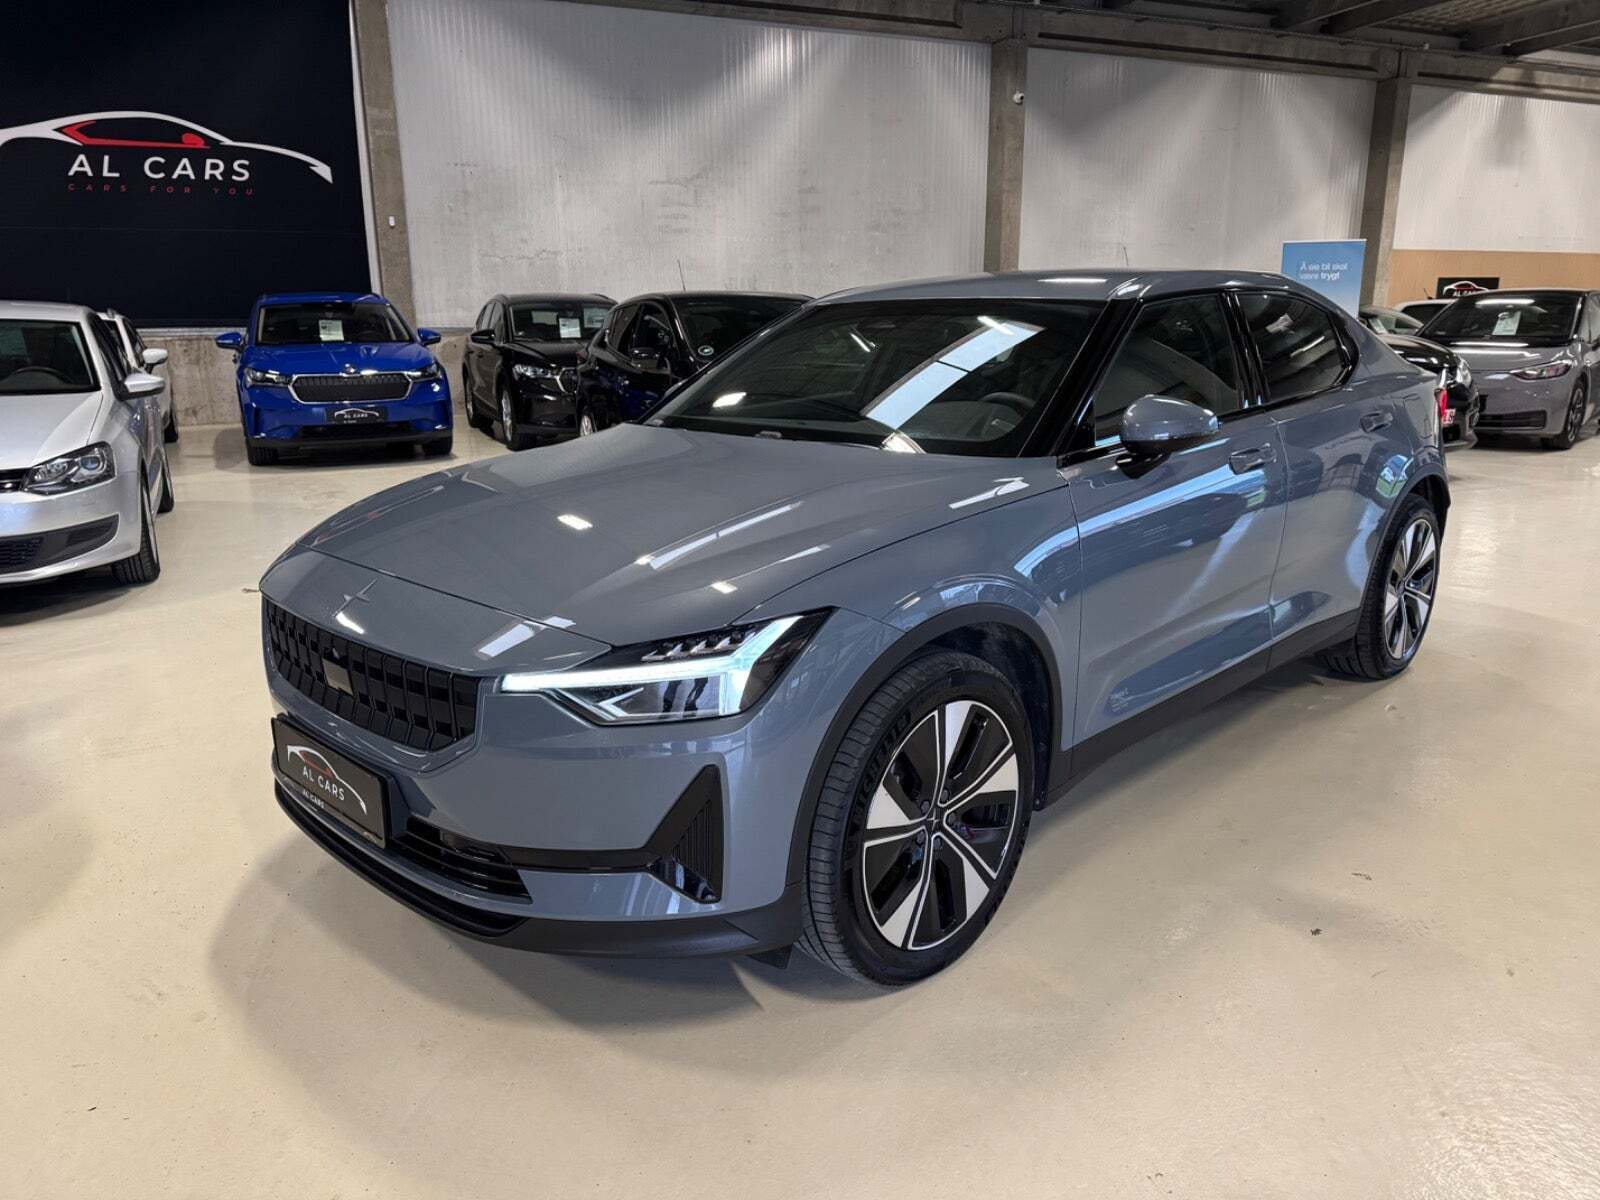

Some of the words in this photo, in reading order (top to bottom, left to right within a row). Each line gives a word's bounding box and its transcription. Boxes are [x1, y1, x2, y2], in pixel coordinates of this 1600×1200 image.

[68, 154, 120, 178] AL
[143, 156, 251, 182] CARS
[67, 183, 129, 193] CARS
[150, 185, 192, 194] FOR
[212, 187, 254, 197] YOU
[1320, 271, 1340, 281] trygt
[302, 766, 314, 782] AL
[317, 775, 345, 801] CARS
